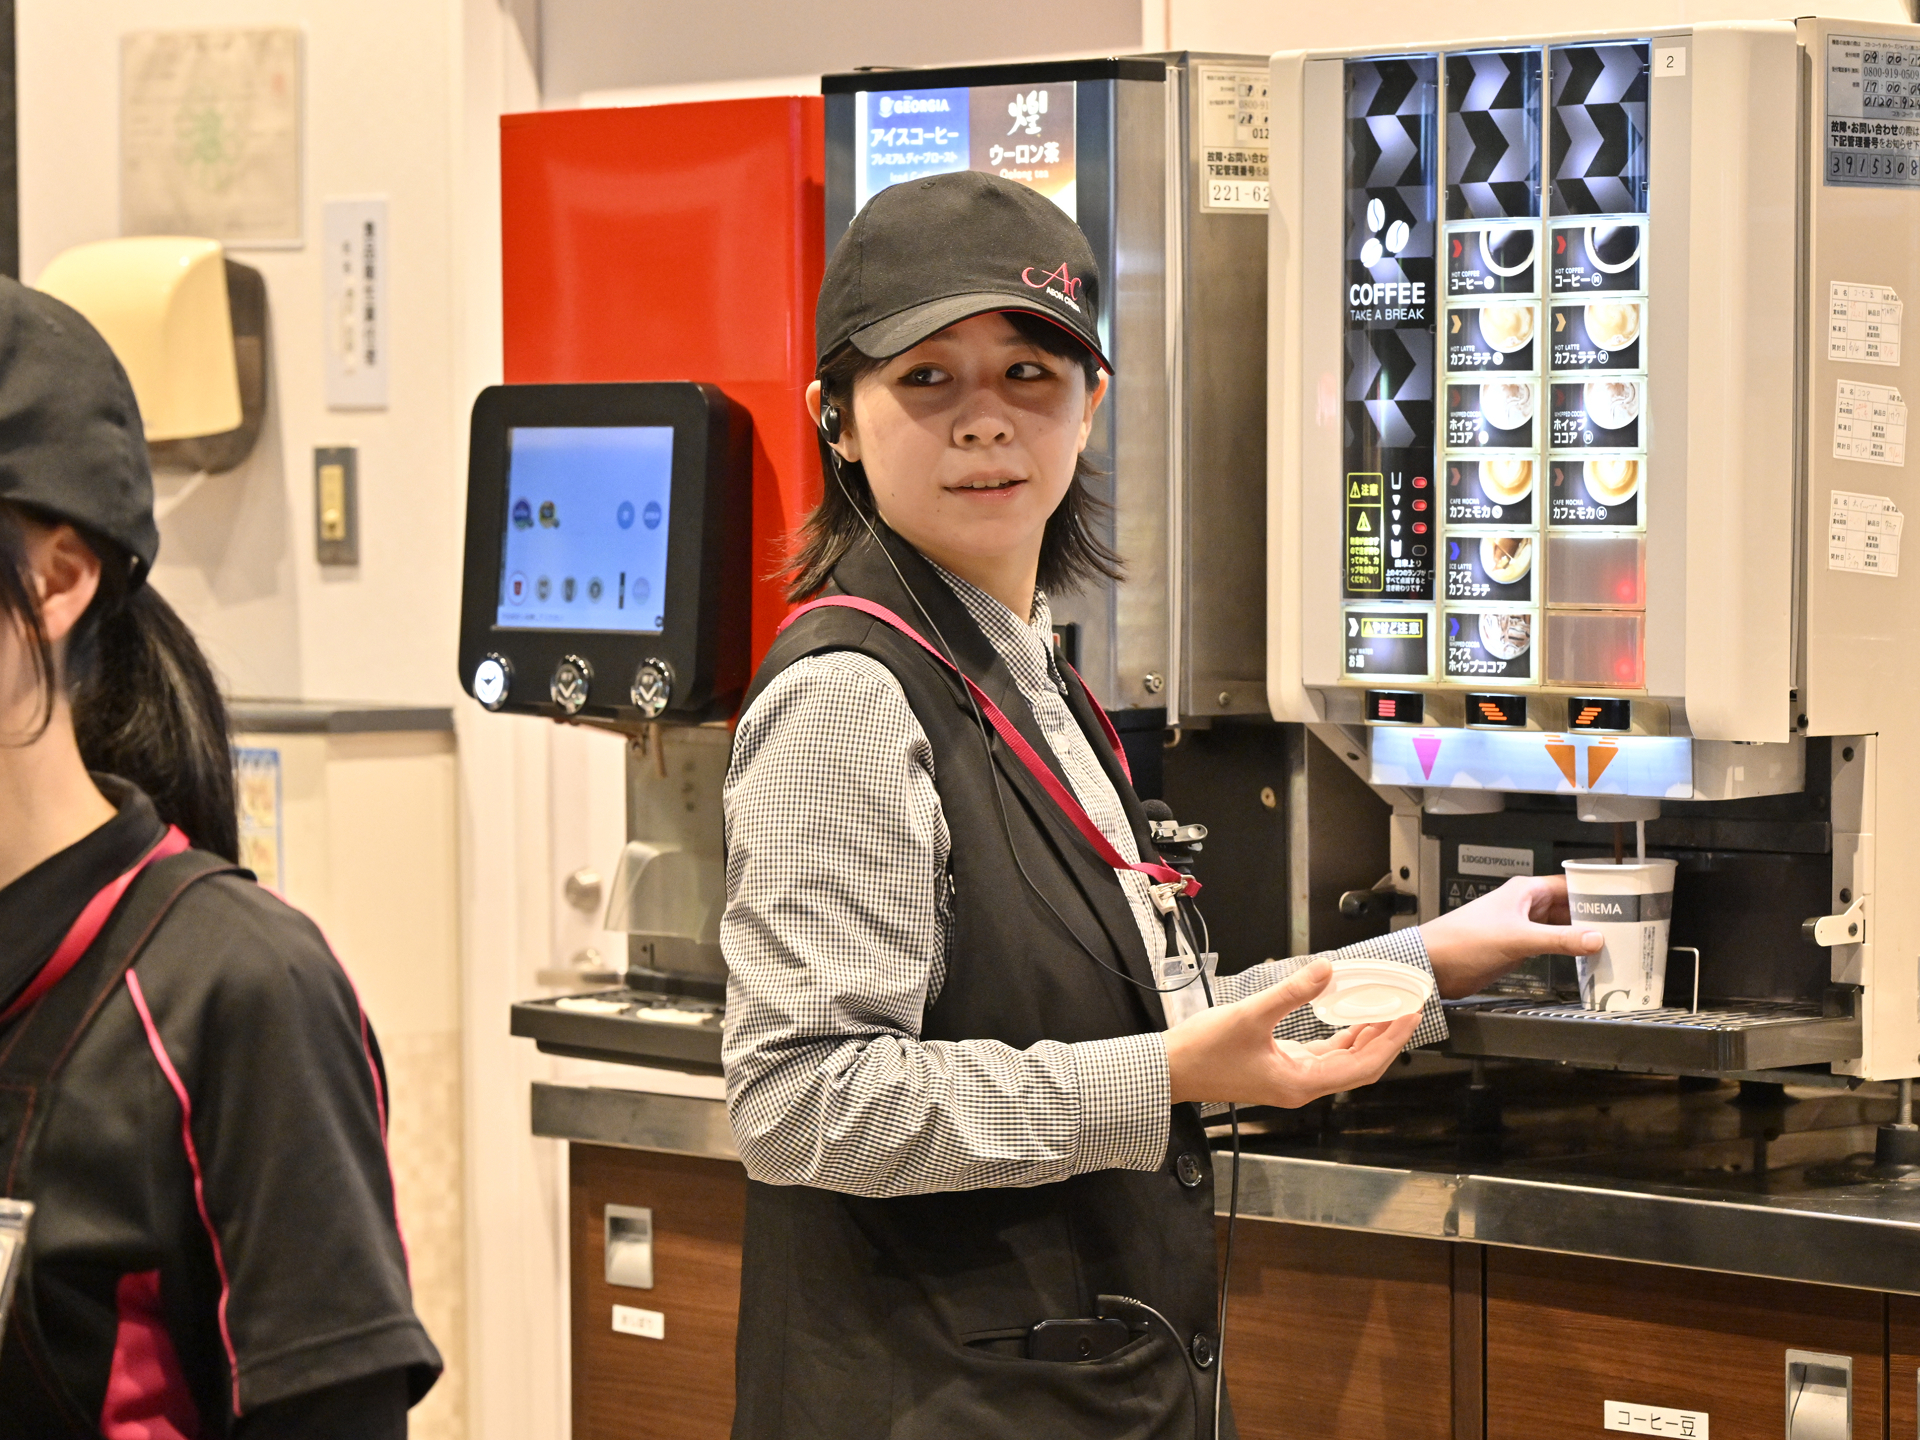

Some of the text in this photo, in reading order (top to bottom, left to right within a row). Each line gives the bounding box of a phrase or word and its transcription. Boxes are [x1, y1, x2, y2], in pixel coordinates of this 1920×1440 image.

[1666, 55, 1675, 68] 2
[893, 98, 950, 114] GEORGIA
[870, 127, 959, 147] アイスコーヒー
[989, 142, 1059, 166] ウーロン茶
[1451, 278, 1483, 290] コーヒー
[1555, 275, 1590, 288] コーヒー
[1350, 282, 1426, 306] COFFEE
[1350, 308, 1425, 321] TAKE A BREAK
[1450, 352, 1492, 366] カフェラテ
[1554, 351, 1597, 365] カフェラテ
[1450, 418, 1483, 431] ホイップ
[1554, 418, 1587, 431] ホイップ
[1450, 432, 1473, 444] ココア
[1554, 432, 1578, 444] ココア
[1361, 484, 1379, 496] 注意
[1450, 505, 1491, 518] カフェモカ
[1553, 507, 1595, 519] カフェモカ
[1449, 571, 1472, 583] アイス
[1449, 584, 1490, 597] カフェラテ
[1449, 648, 1471, 660] アイス
[1449, 659, 1507, 673] ホイップココア
[1577, 902, 1622, 915] CINEMA
[1618, 1410, 1697, 1438] コーヒー豆
